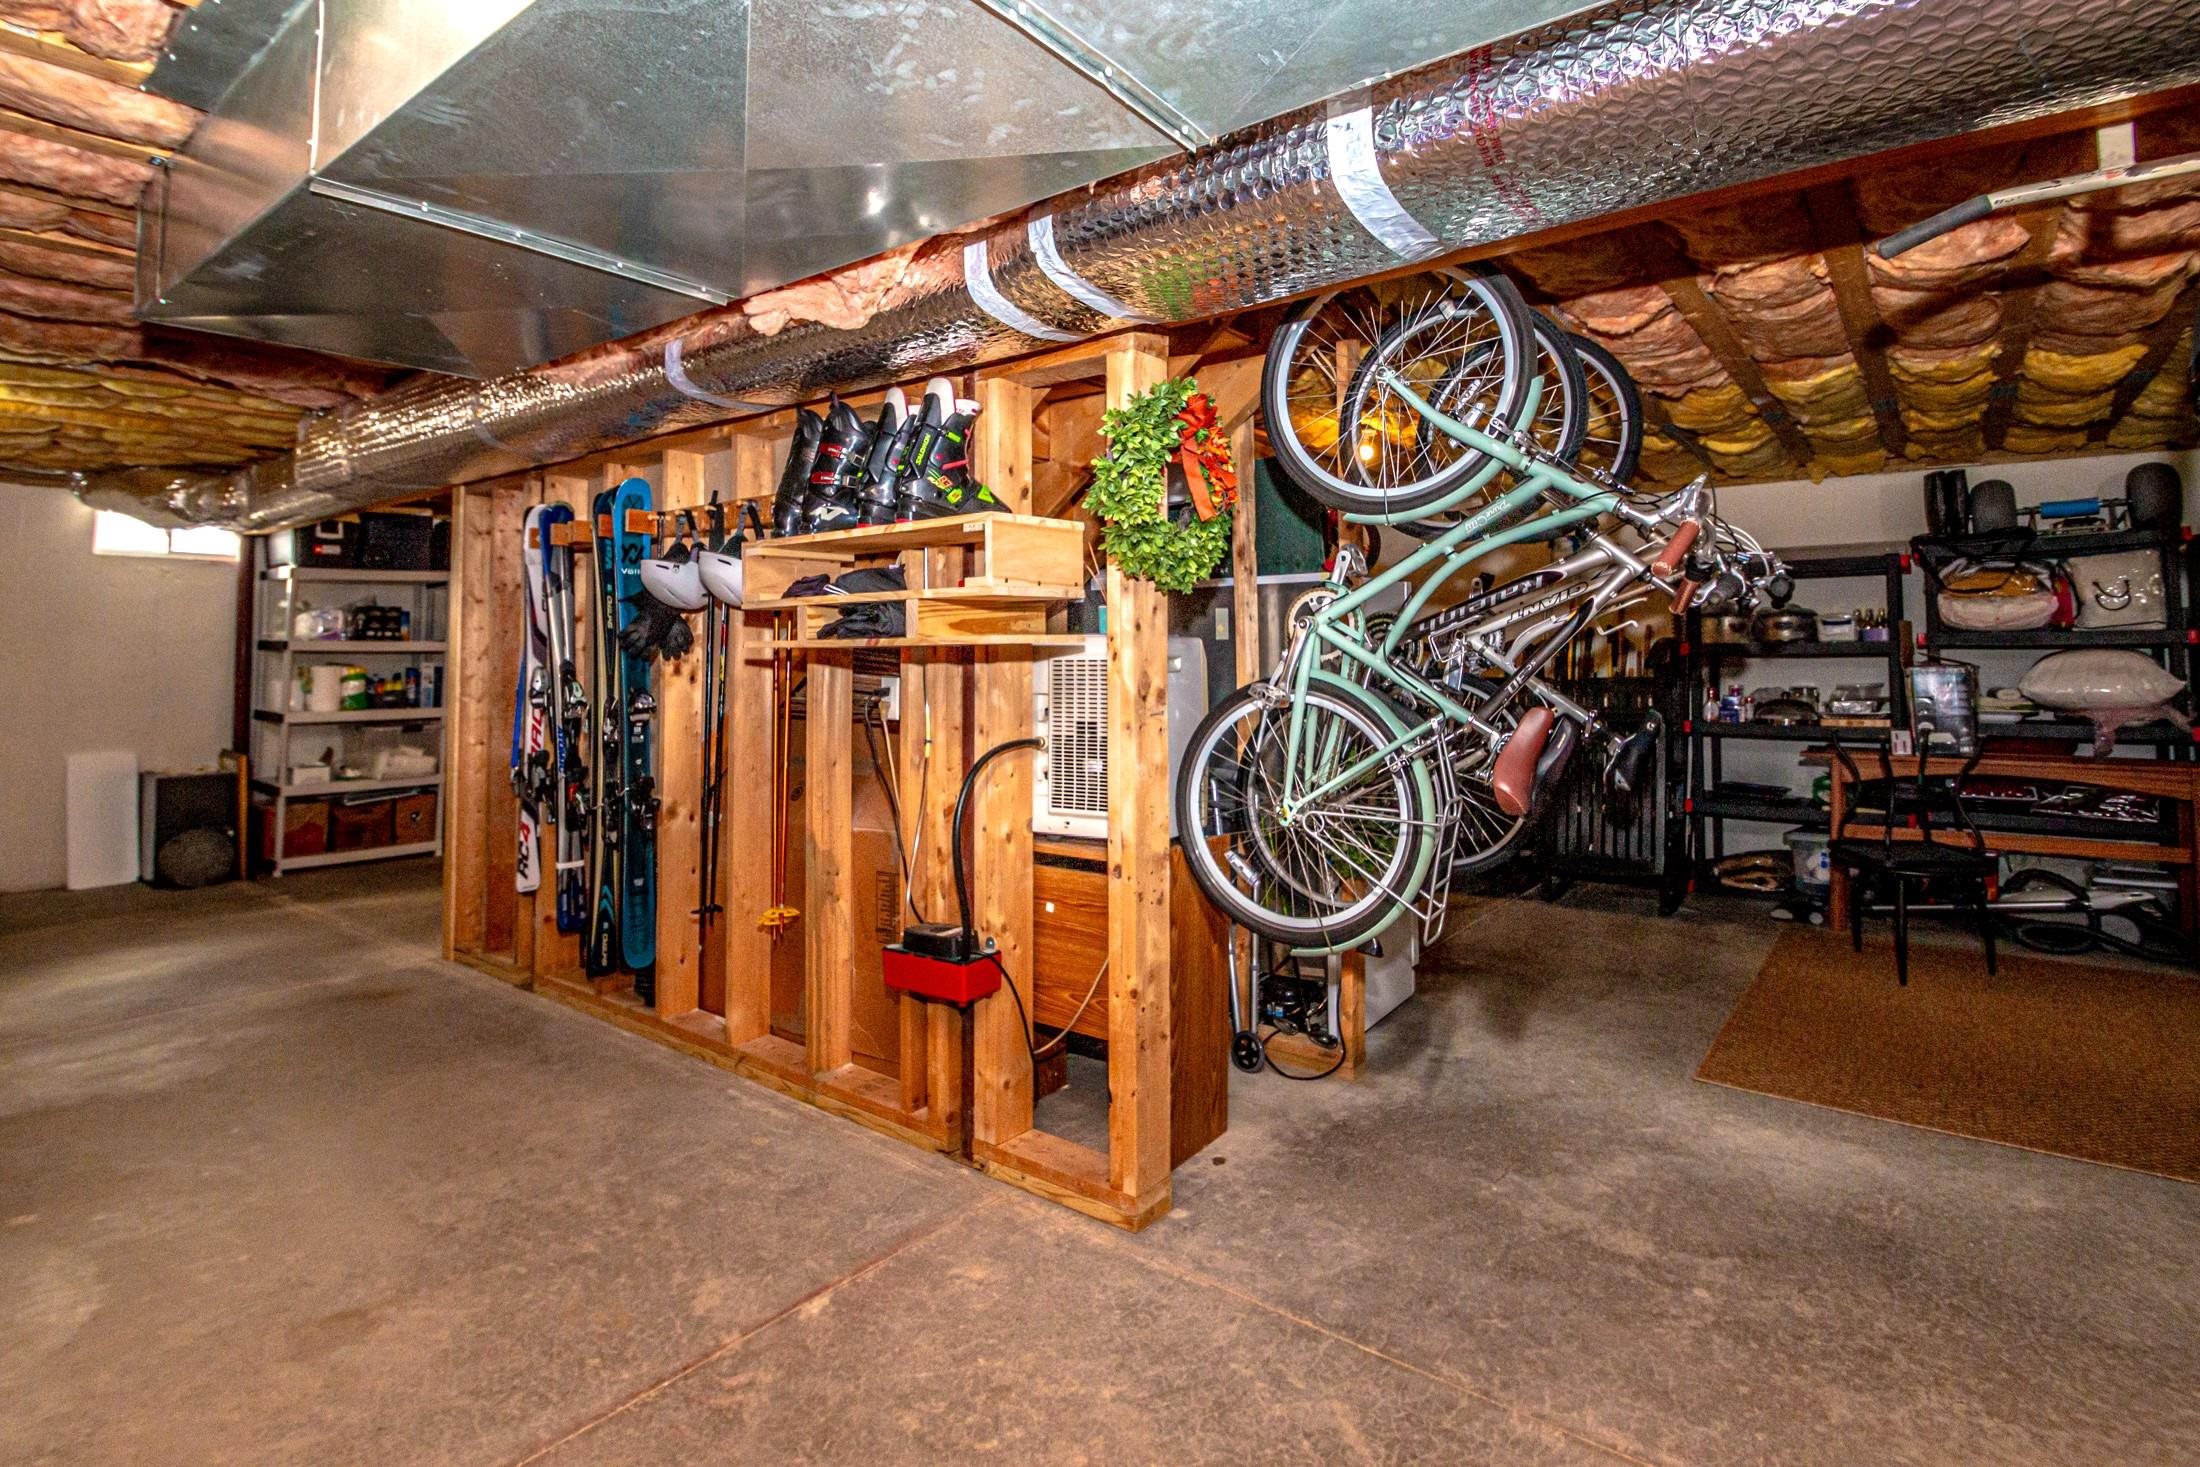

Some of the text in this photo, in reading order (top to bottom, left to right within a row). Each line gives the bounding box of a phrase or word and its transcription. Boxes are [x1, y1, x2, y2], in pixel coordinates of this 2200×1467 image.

[915, 432, 931, 465] SALOMON
[1507, 581, 1588, 624] GIANT
[516, 820, 531, 880] RC4
